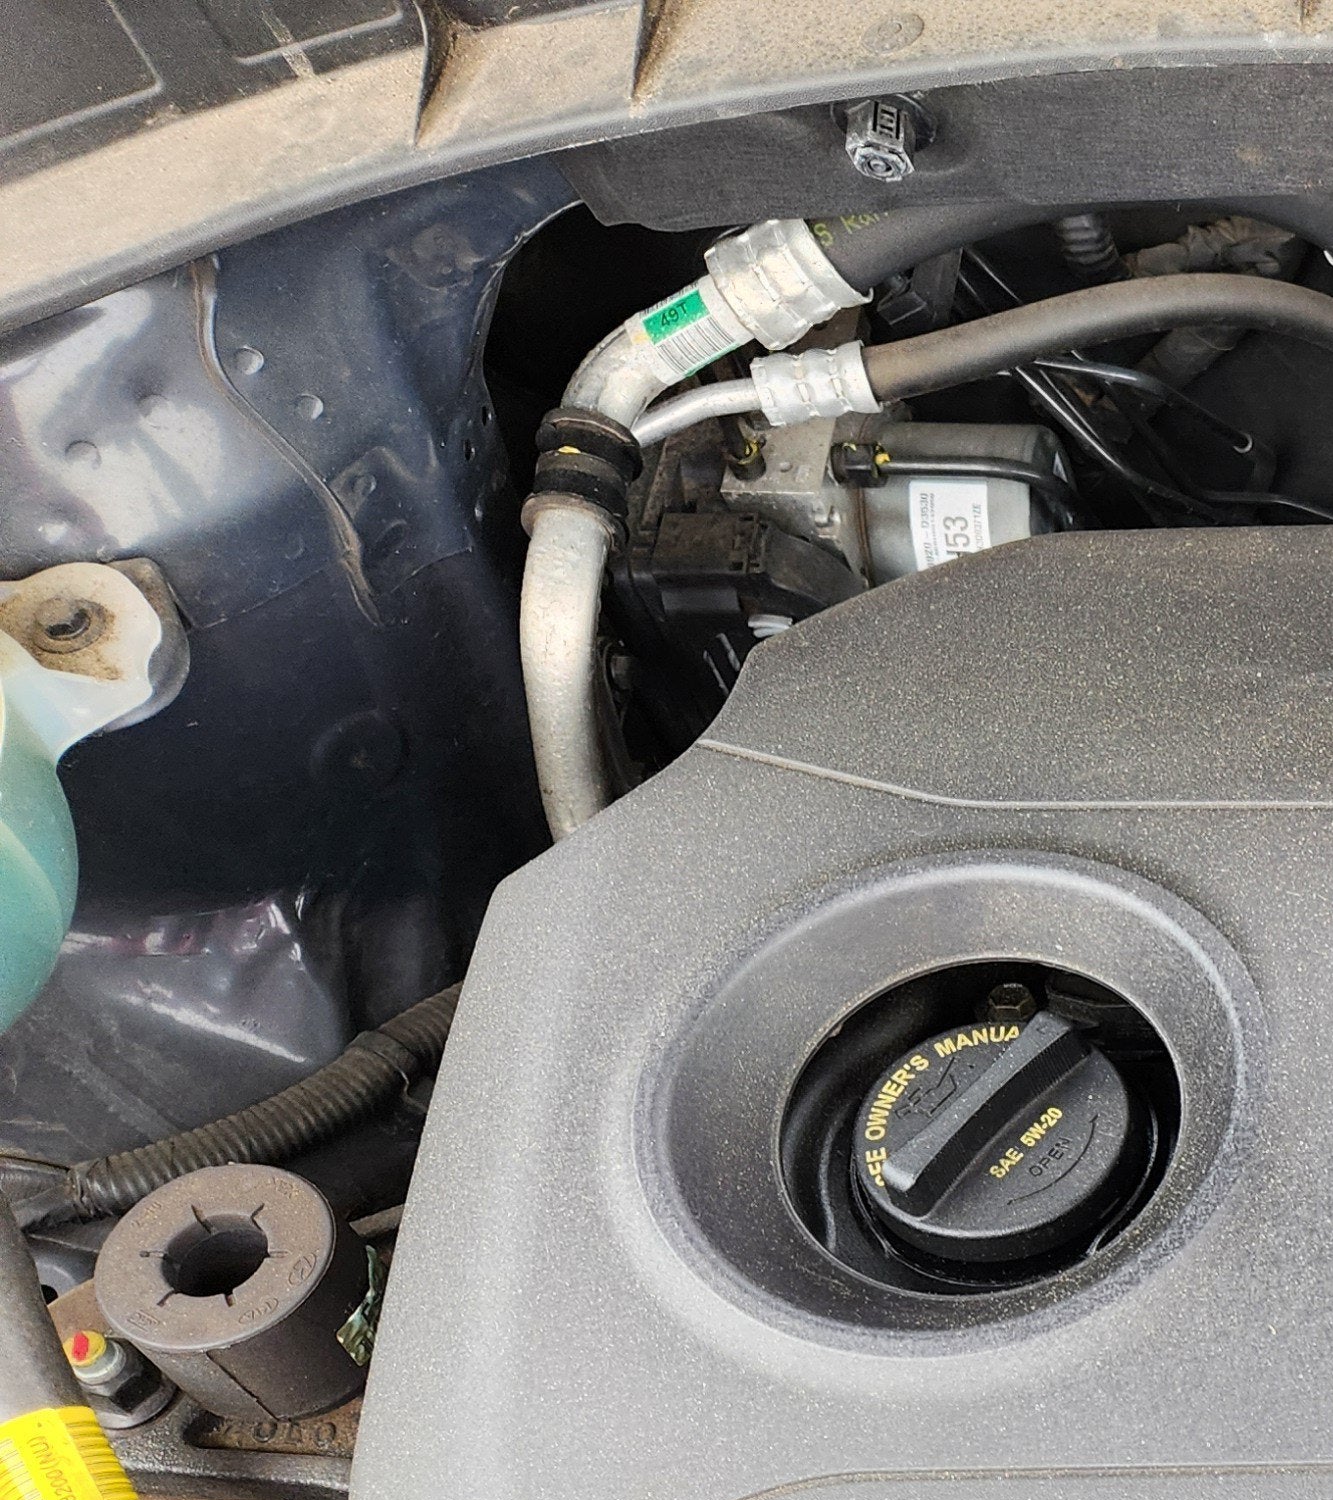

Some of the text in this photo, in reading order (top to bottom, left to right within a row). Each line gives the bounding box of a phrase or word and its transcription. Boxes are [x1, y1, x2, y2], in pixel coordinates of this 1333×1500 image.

[661, 302, 688, 328] 49T
[865, 1054, 930, 1142] OWNER'S
[933, 1025, 1021, 1058] MANUA
[989, 1107, 1064, 1180] SAE 5W-20
[1028, 1136, 1073, 1178] OPEN
